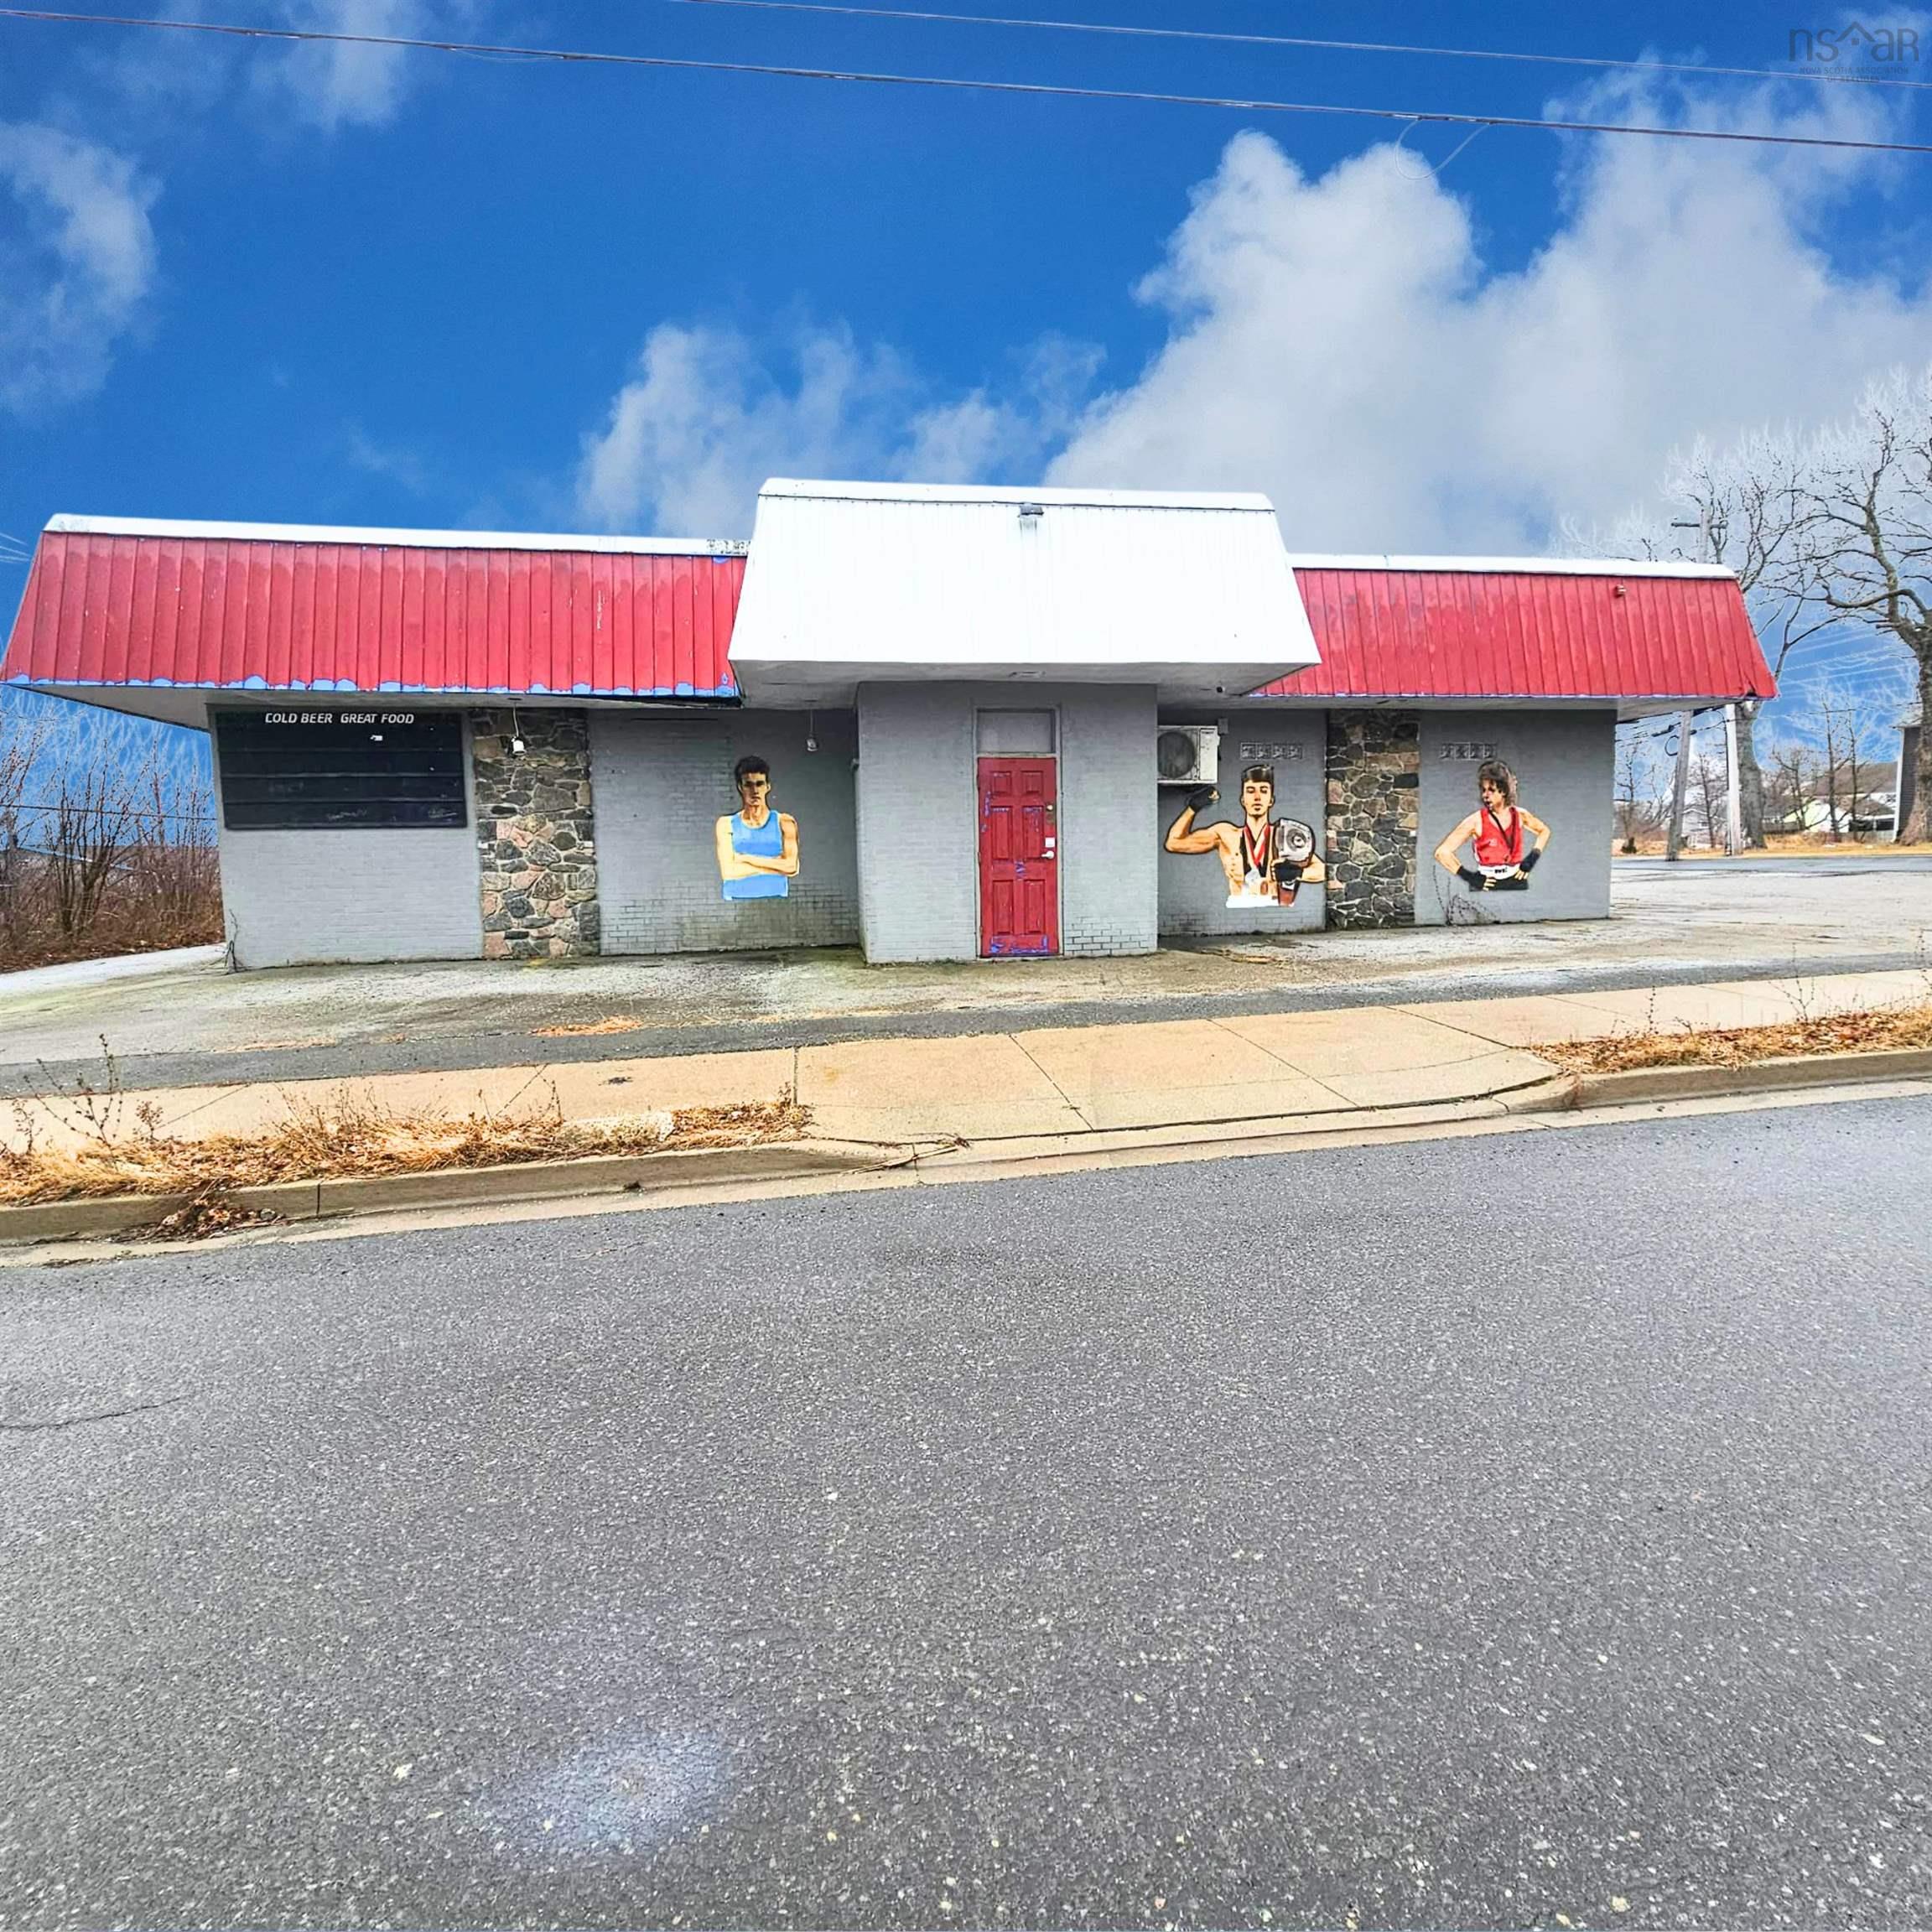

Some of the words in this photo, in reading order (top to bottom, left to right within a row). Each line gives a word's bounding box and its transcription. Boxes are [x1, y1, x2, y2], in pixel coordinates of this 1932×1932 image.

[264, 713, 298, 724] COLD
[300, 713, 333, 724] BEER
[340, 713, 378, 724] GREAT
[381, 713, 415, 724] FOOD
